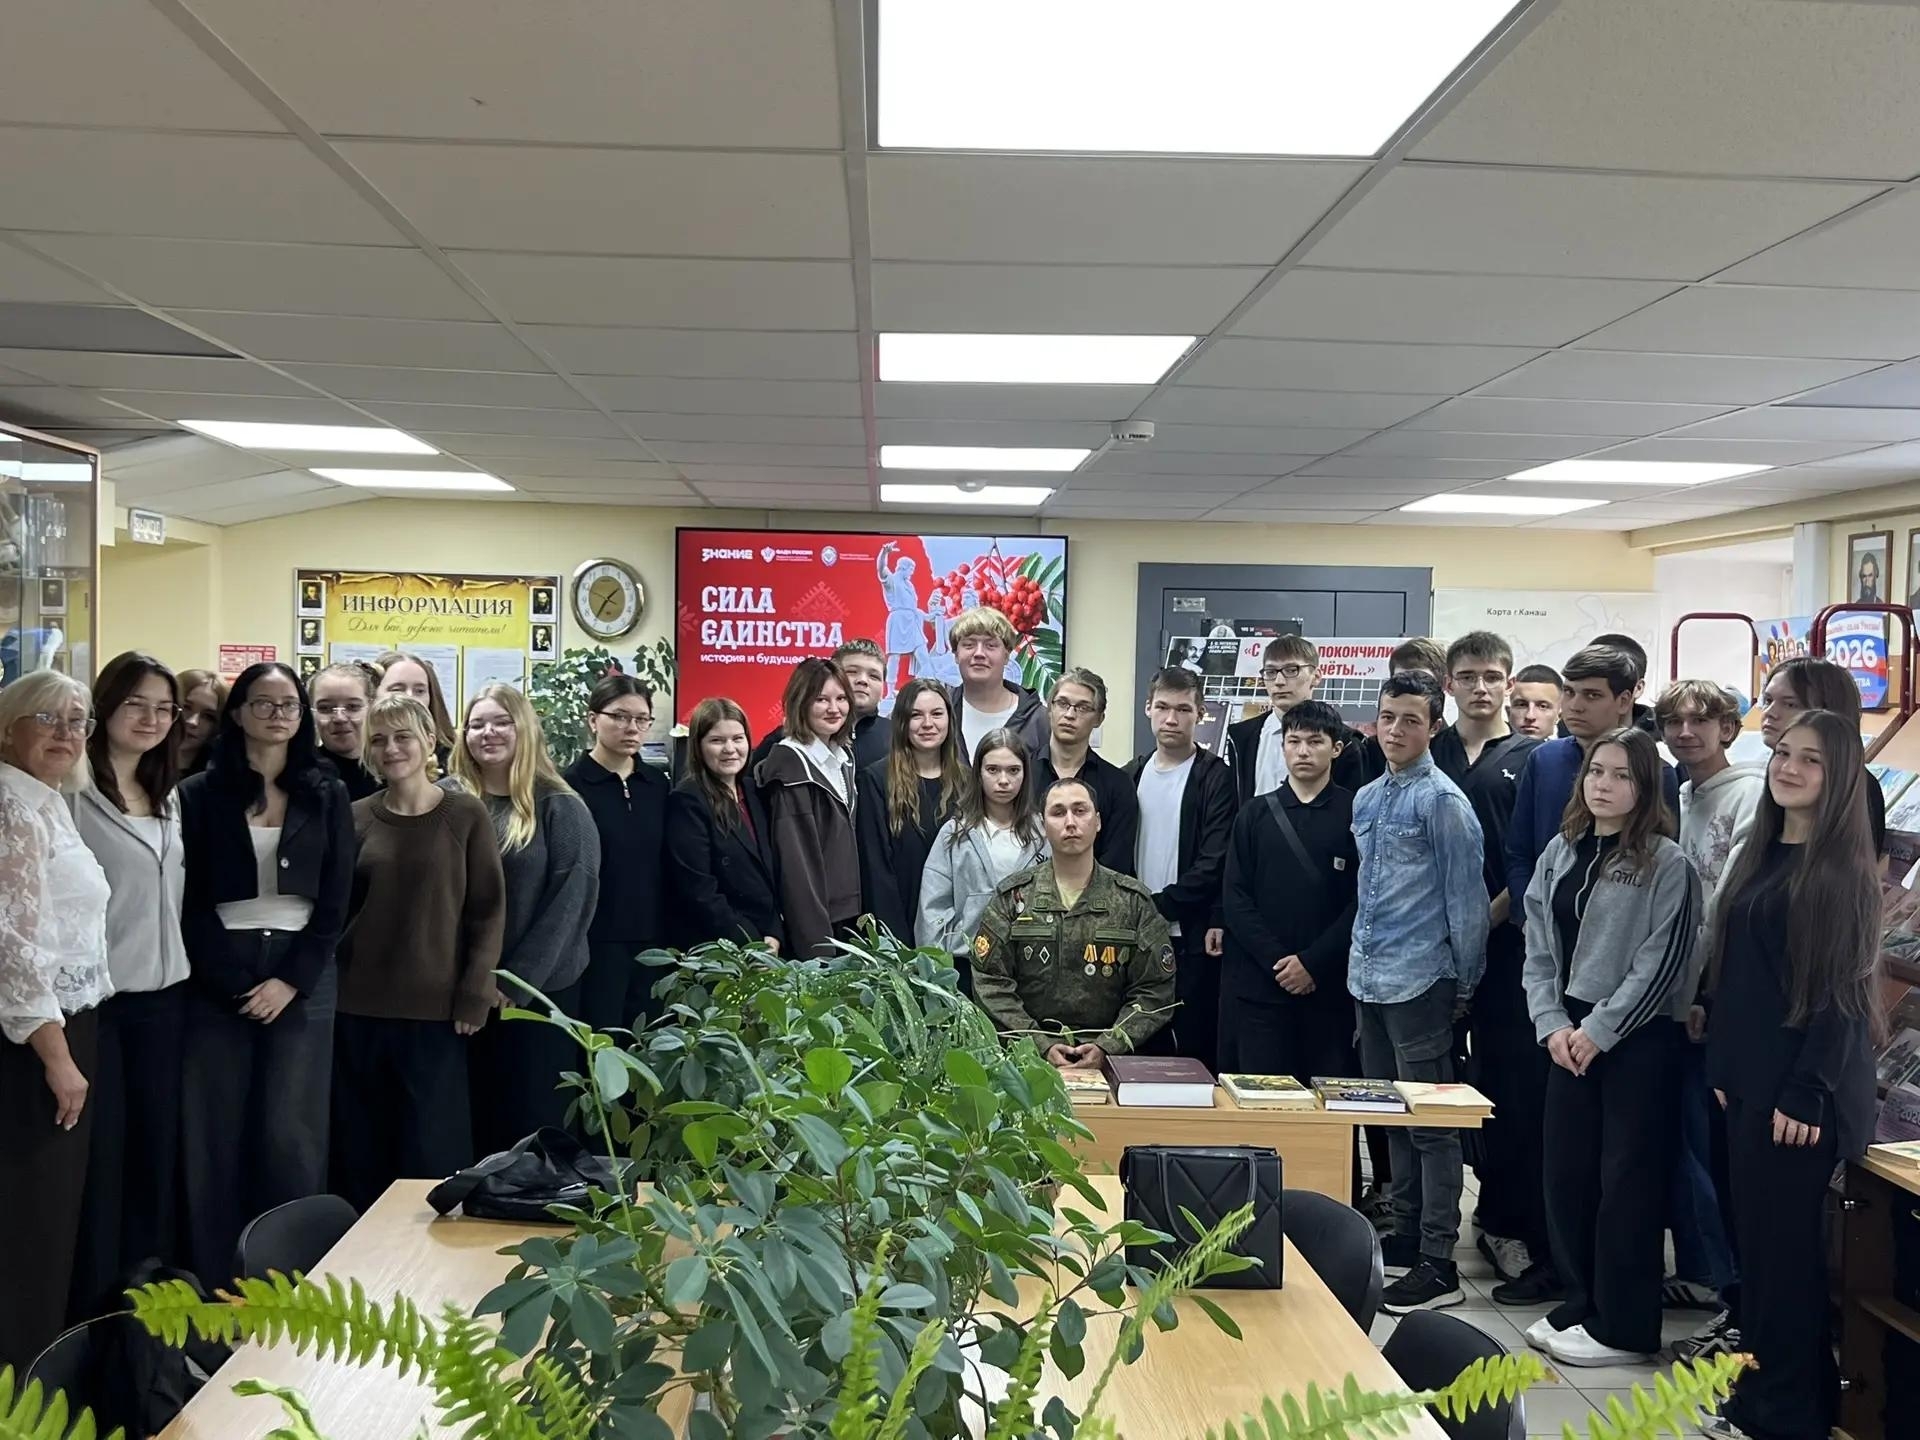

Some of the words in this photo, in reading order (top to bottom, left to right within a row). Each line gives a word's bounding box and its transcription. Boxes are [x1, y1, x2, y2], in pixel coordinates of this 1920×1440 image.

[342, 595, 513, 619] ИНФОРМАЦИЯ
[701, 585, 776, 614] СИЛА
[1486, 608, 1512, 616] Карта
[348, 617, 379, 632] Для
[700, 654, 745, 664] история
[756, 653, 805, 666] будущее
[1318, 646, 1394, 658] покончили
[1826, 639, 1877, 668] 2026
[1320, 660, 1375, 676] чёты...»
